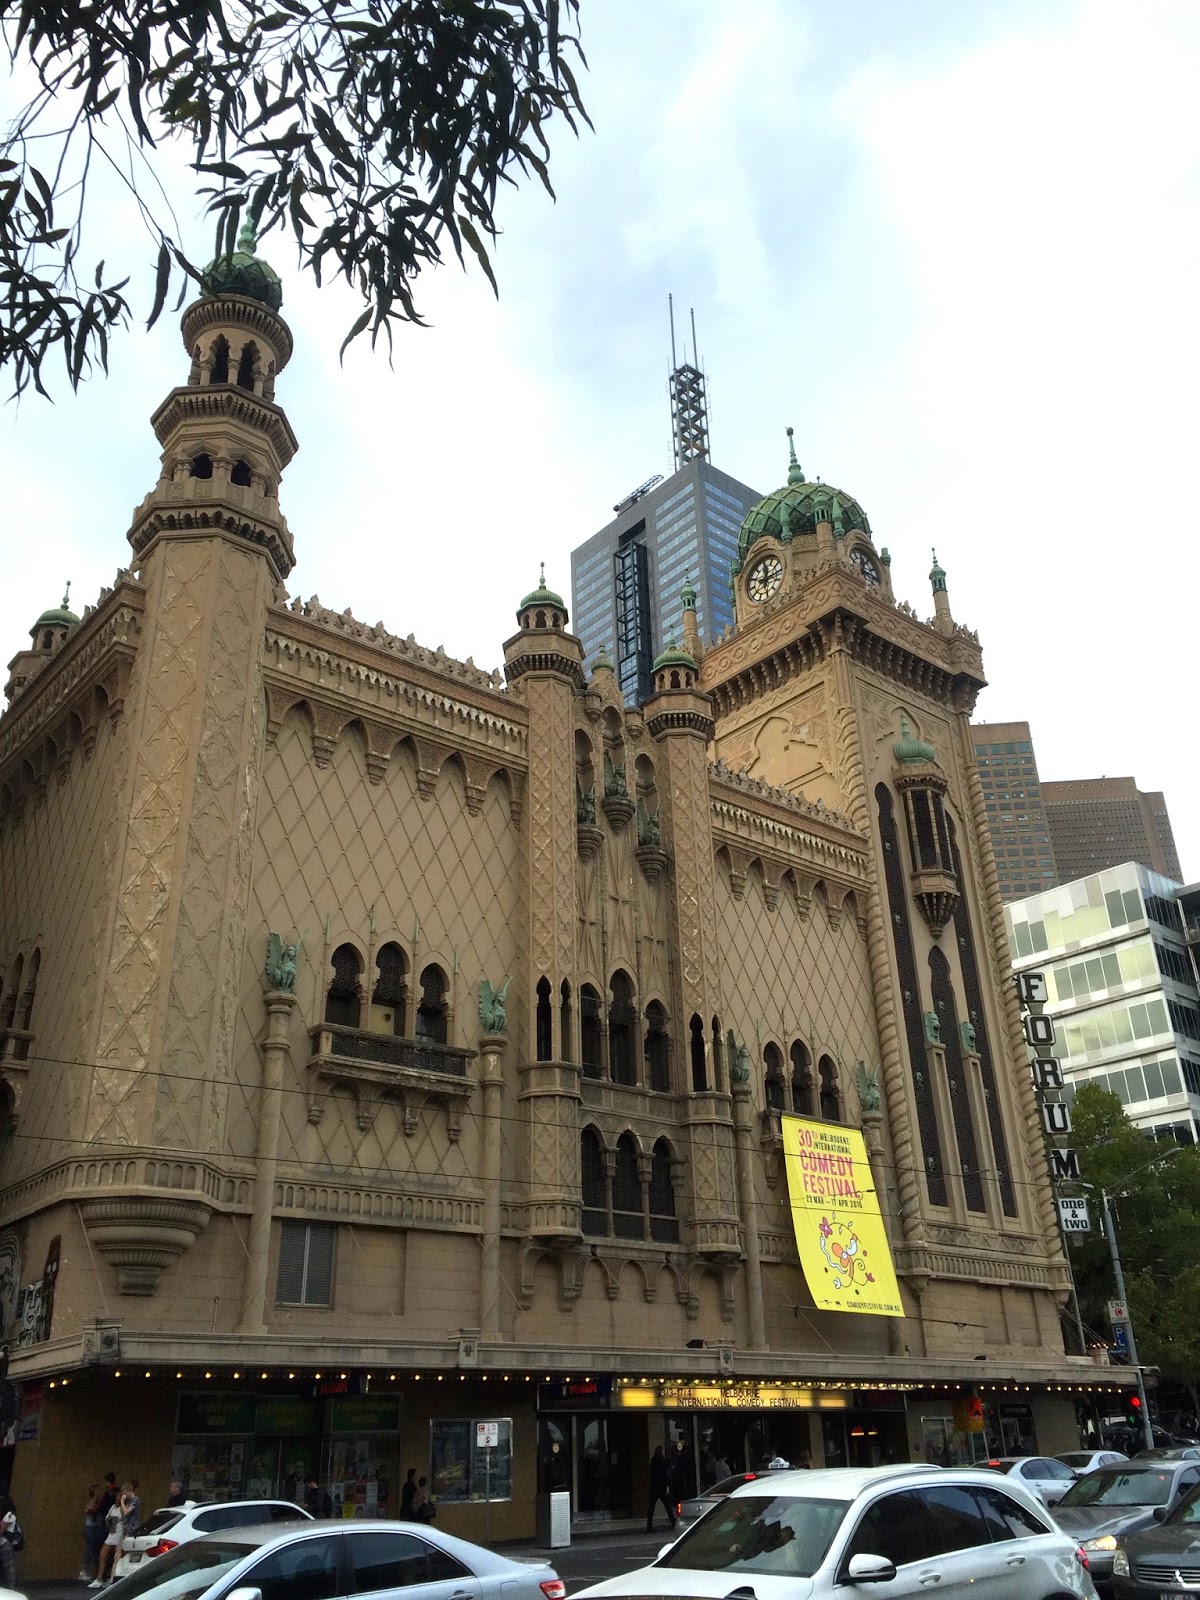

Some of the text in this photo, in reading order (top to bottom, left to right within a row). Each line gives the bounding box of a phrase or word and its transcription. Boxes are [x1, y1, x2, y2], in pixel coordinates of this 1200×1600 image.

[1055, 781, 1132, 792] SOFITEL
[1022, 974, 1080, 1179] FORUM
[819, 1132, 850, 1145] MELBOURNE
[813, 1141, 852, 1155] INTERNATIONAL
[799, 1149, 854, 1177] COMEDY
[803, 1173, 861, 1199] FESTIVAL
[813, 1196, 825, 1205] MAR
[838, 1199, 849, 1208] APR
[1061, 1200, 1085, 1209] one
[1071, 1209, 1078, 1219] &
[1064, 1218, 1088, 1229] two
[1115, 1327, 1124, 1338] P
[720, 1387, 760, 1398] MELBOURNE
[677, 1398, 800, 1408] INTERNATIONAL COMEDY FESTIVAL
